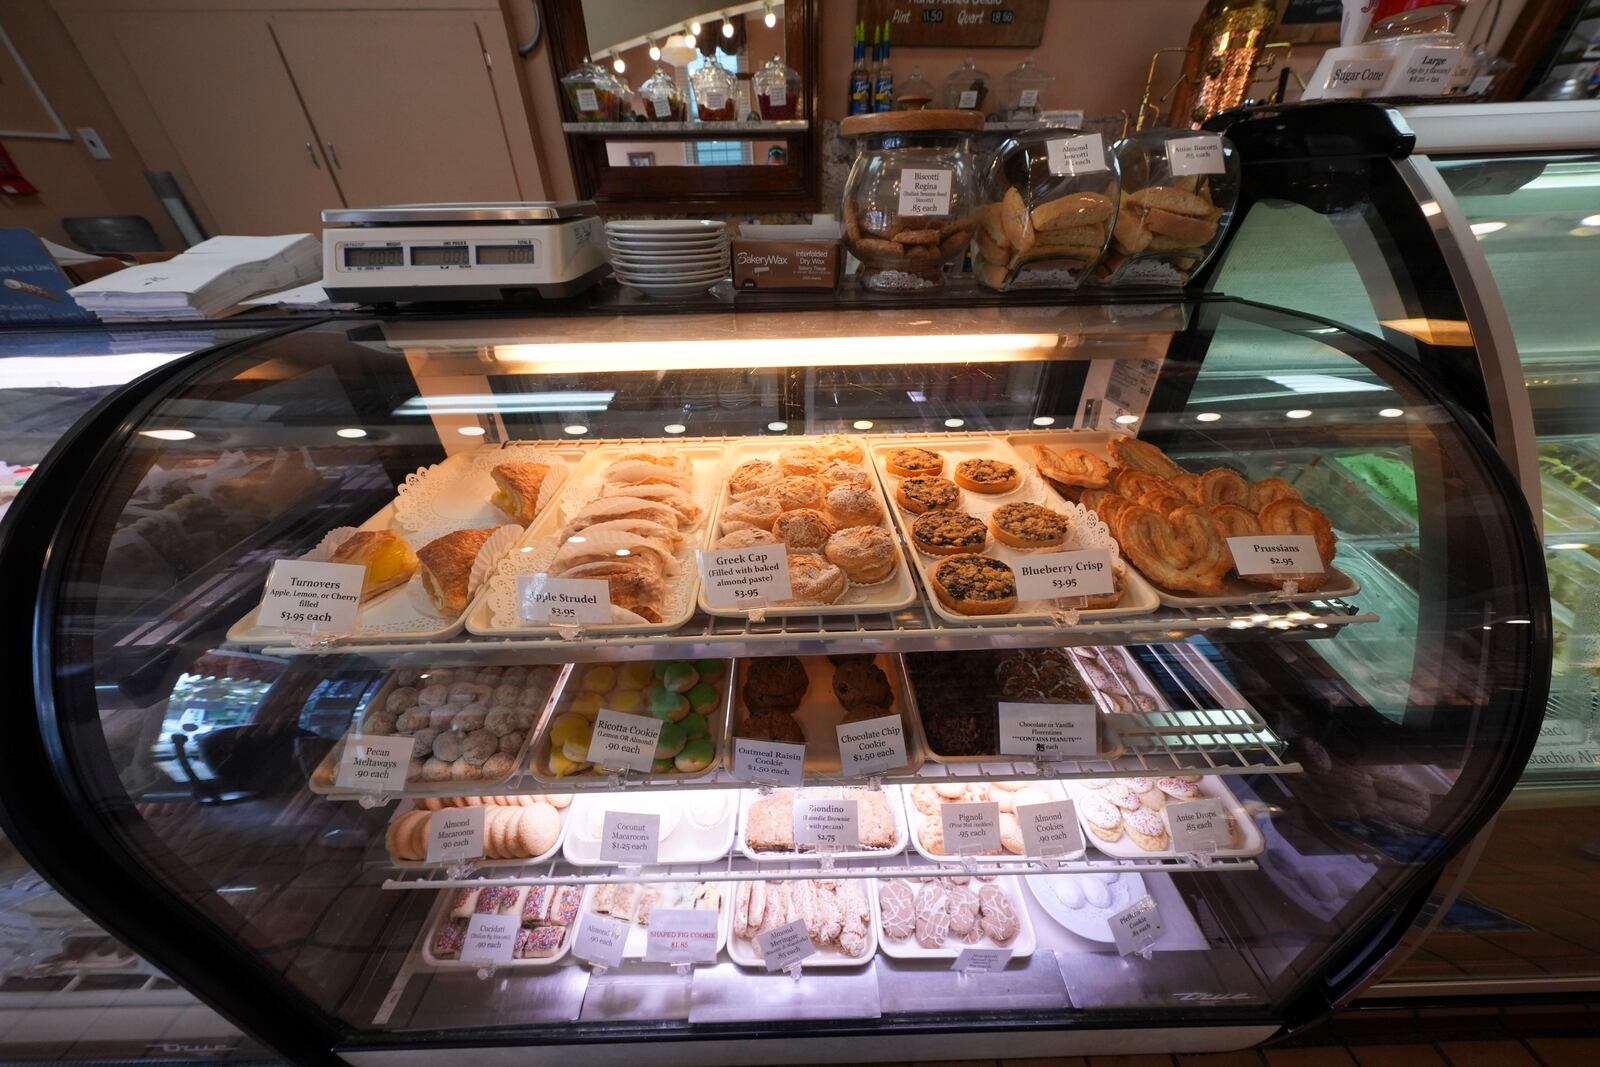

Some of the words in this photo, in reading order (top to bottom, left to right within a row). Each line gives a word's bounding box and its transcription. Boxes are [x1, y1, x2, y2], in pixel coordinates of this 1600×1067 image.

[891, 9, 911, 24] Pint
[957, 10, 985, 25] Quart
[1422, 56, 1447, 66] Large
[1333, 69, 1361, 81] Sugar
[1361, 68, 1384, 80] Cone
[914, 172, 939, 180] Biscotti
[914, 182, 937, 191] Regina
[922, 204, 938, 212] each
[737, 251, 788, 265] BakeryWax
[796, 250, 828, 258] Interfolded
[1253, 544, 1300, 553] Prussians
[716, 554, 746, 565] Greek
[748, 553, 768, 563] Cap
[1270, 558, 1294, 566] $2.95
[708, 568, 733, 578] (Filled
[735, 566, 753, 575] with
[754, 563, 779, 573] baked
[1022, 565, 1073, 576] Blueberry
[1076, 561, 1103, 572] Crisp
[291, 577, 341, 589] Turnovers
[717, 577, 747, 587] almond
[749, 574, 773, 585] paste)
[1052, 578, 1077, 588] $3.95
[270, 589, 292, 597] Apple,
[293, 590, 319, 599] Lemon,
[331, 592, 358, 602] Cherry
[559, 593, 597, 604] Strudel
[735, 589, 759, 598] $3.95
[299, 600, 319, 608] filled
[281, 611, 304, 622] $3.95
[307, 612, 332, 622] each
[551, 607, 575, 617] $3.95
[598, 720, 628, 733] Ricotta
[629, 725, 658, 739] Cookie
[841, 731, 880, 743] Chocolate
[881, 726, 900, 737] Chip
[597, 730, 619, 740] (Lemon
[629, 736, 654, 746] Almond)
[605, 742, 620, 751] .90
[621, 745, 641, 755] each
[859, 740, 886, 751] Cookie
[366, 747, 390, 757] Pecan
[738, 747, 773, 758] Oatmeal
[775, 752, 801, 761] Raisin
[853, 753, 875, 762] $1.50
[877, 748, 895, 758] each
[755, 757, 783, 767] Cookie
[1529, 751, 1575, 764] stachio
[353, 757, 397, 770] Meltaways
[747, 764, 769, 773] $1.50
[355, 770, 368, 778] .90
[370, 770, 389, 779] each
[959, 813, 983, 822] Pignoli
[1034, 811, 1063, 823] Almond
[1196, 811, 1216, 820] Drops
[444, 819, 470, 829] Almond
[617, 823, 645, 831] Coconut
[1036, 823, 1064, 833] Cookies
[1197, 821, 1212, 829] each
[438, 830, 474, 839] Macaroons
[612, 832, 649, 841] Macaroons
[970, 829, 986, 837] each
[1051, 832, 1067, 840] each
[453, 838, 469, 847] each
